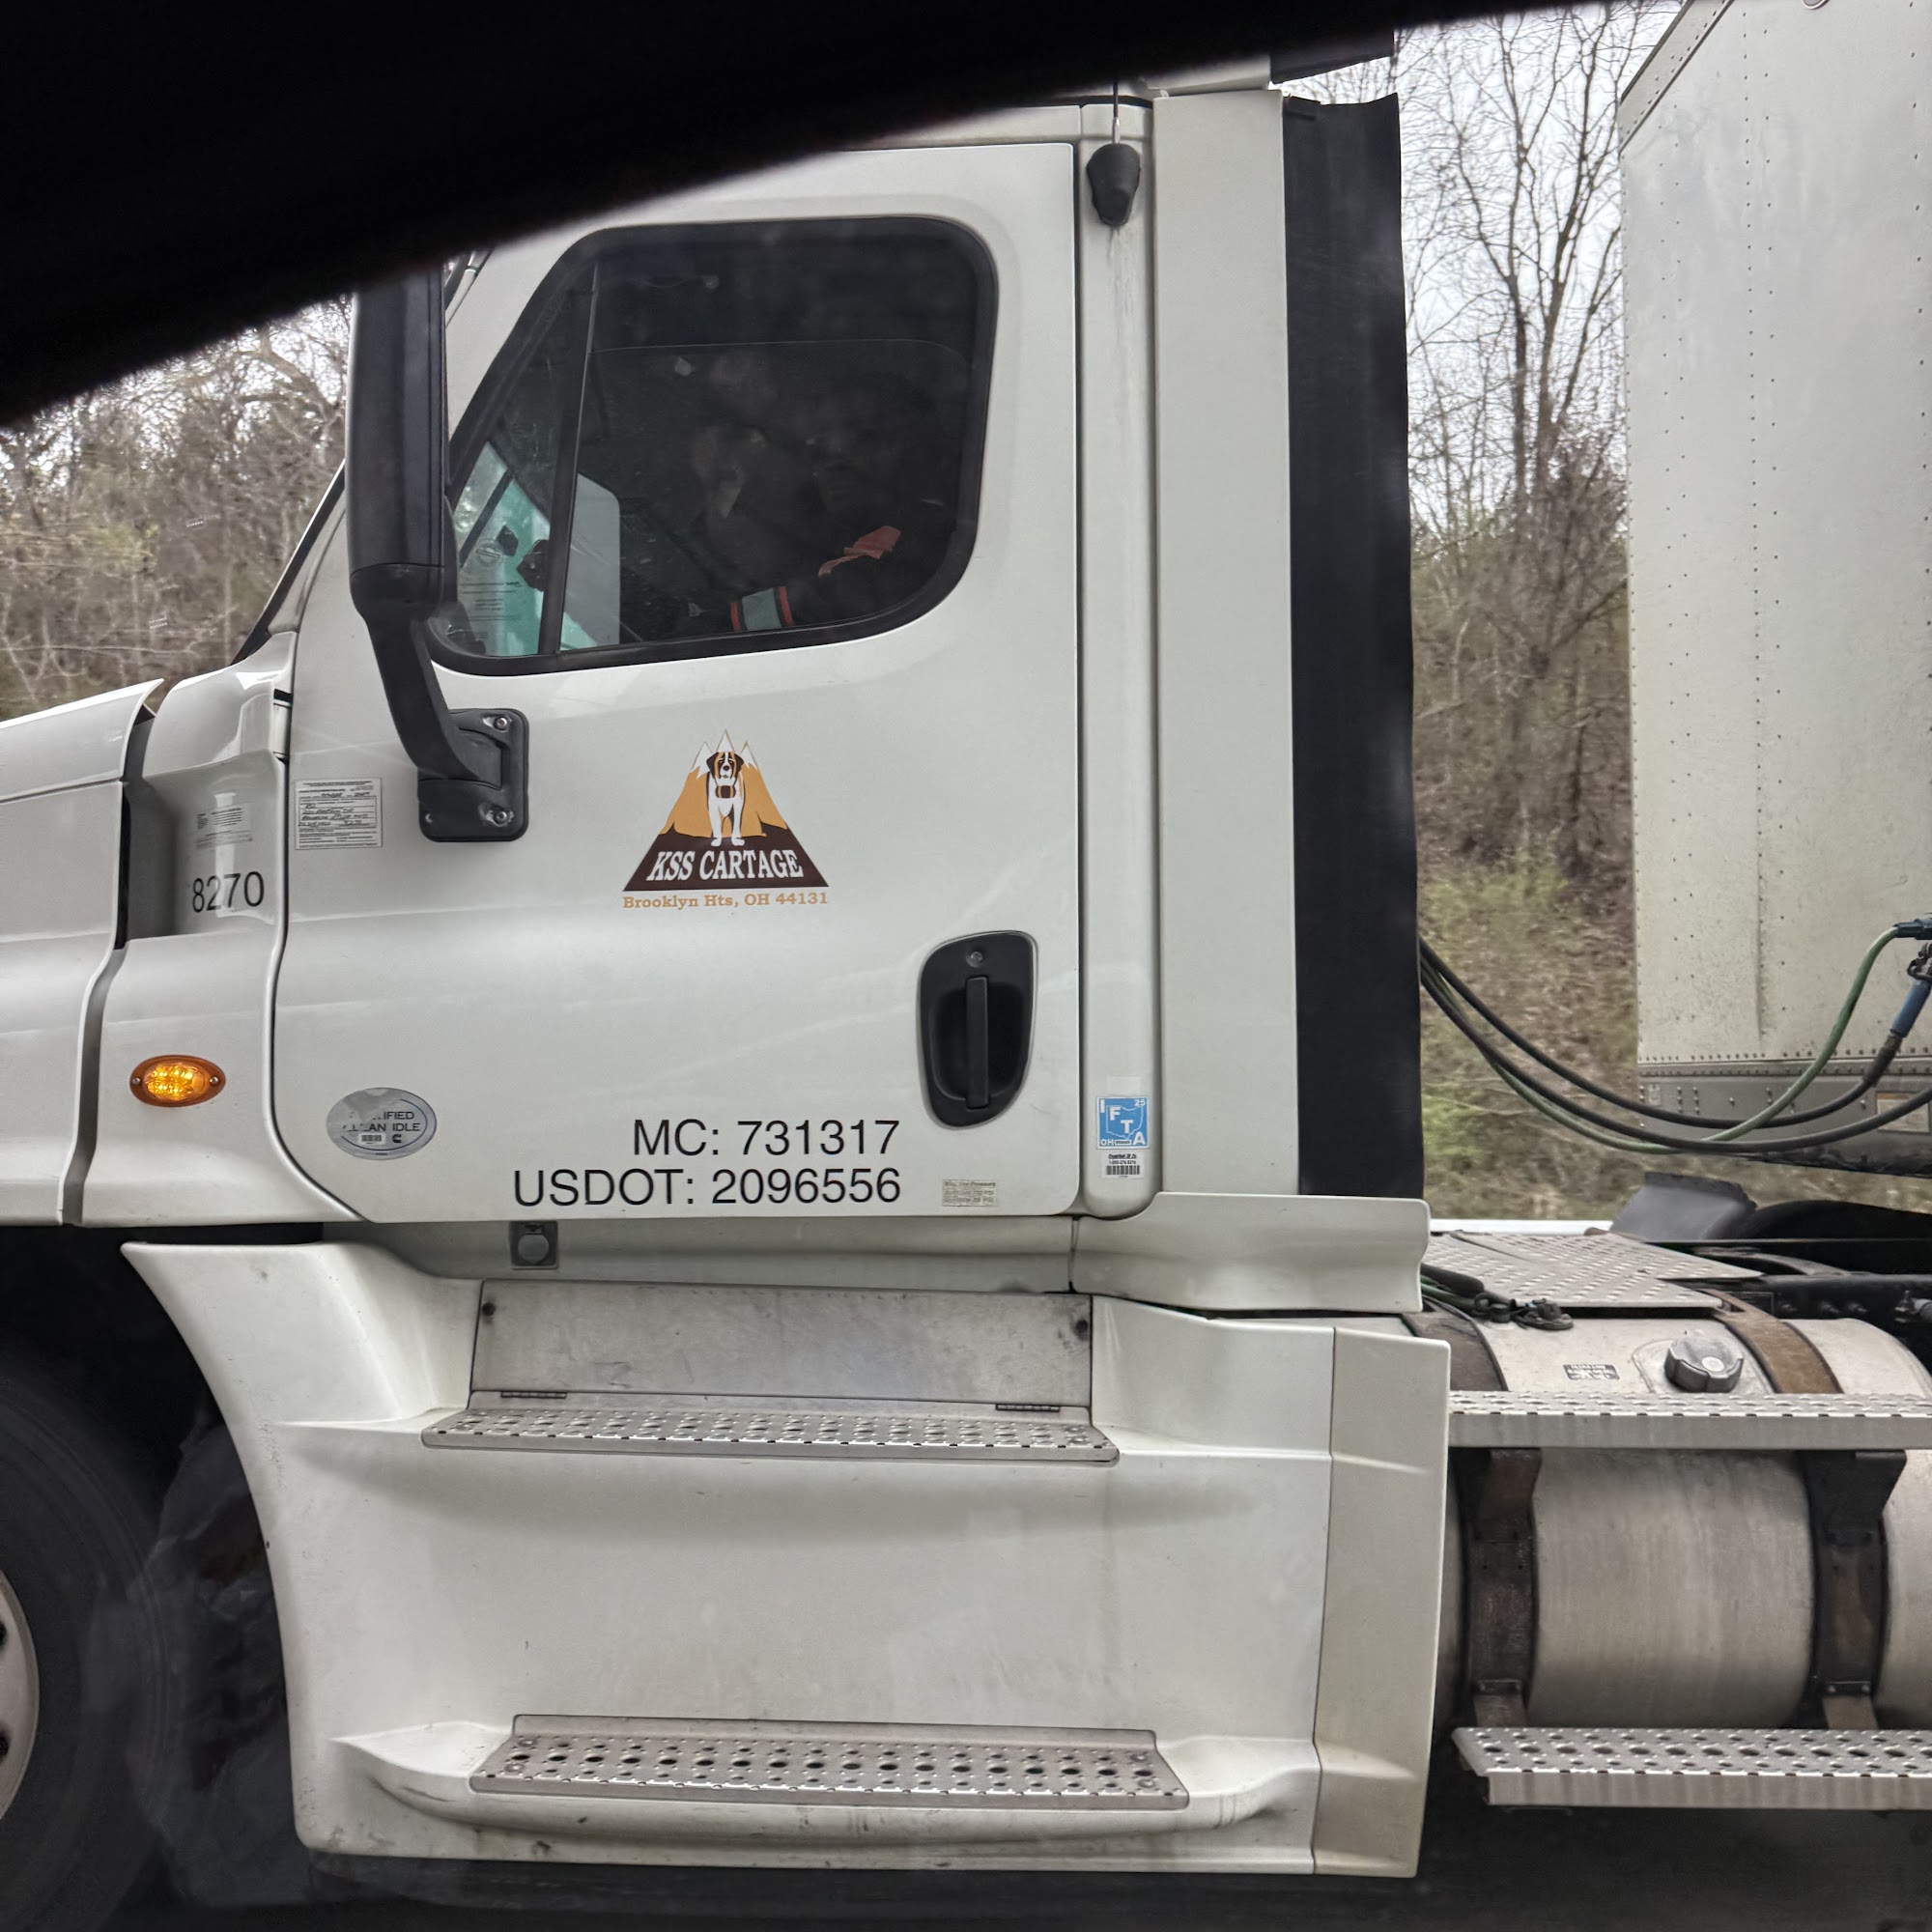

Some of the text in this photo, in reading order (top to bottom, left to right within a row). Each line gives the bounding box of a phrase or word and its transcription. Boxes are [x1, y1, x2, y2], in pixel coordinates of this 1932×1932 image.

[645, 849, 804, 882] KSS CARTAGE
[192, 870, 265, 913] 8270
[622, 892, 828, 910] Brooklyn Hts, OH 44131
[392, 1122, 421, 1132] IDLE
[634, 1119, 900, 1155] MC: 731317
[513, 1168, 694, 1207] USDOT:
[712, 1167, 900, 1205] 2096556
